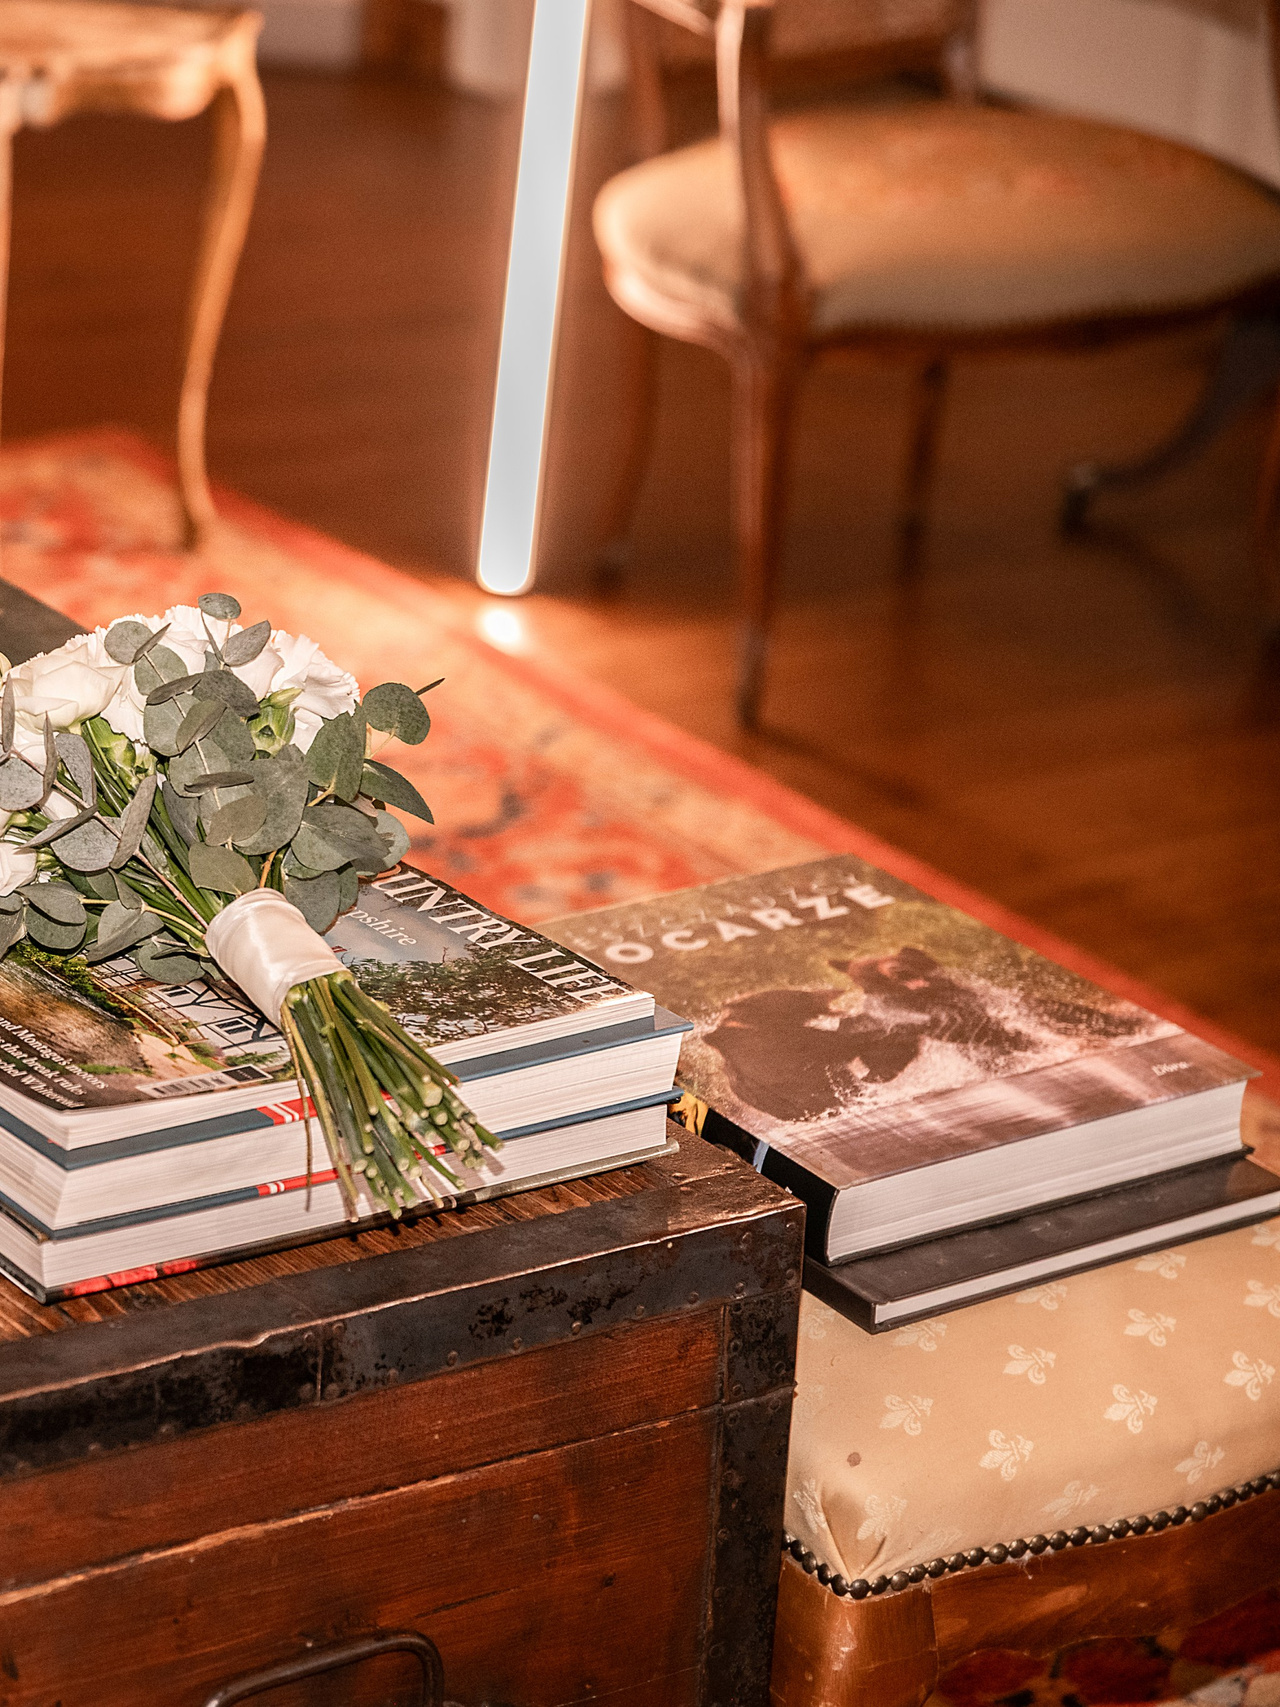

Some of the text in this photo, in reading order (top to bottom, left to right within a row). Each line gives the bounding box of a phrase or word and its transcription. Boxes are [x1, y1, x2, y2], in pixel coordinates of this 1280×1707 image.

[338, 907, 417, 946] pshire
[360, 866, 634, 1004] UNTRY LIFE
[604, 884, 896, 964] OCARZE
[1, 1042, 29, 1060] that
[65, 1065, 109, 1089] motors
